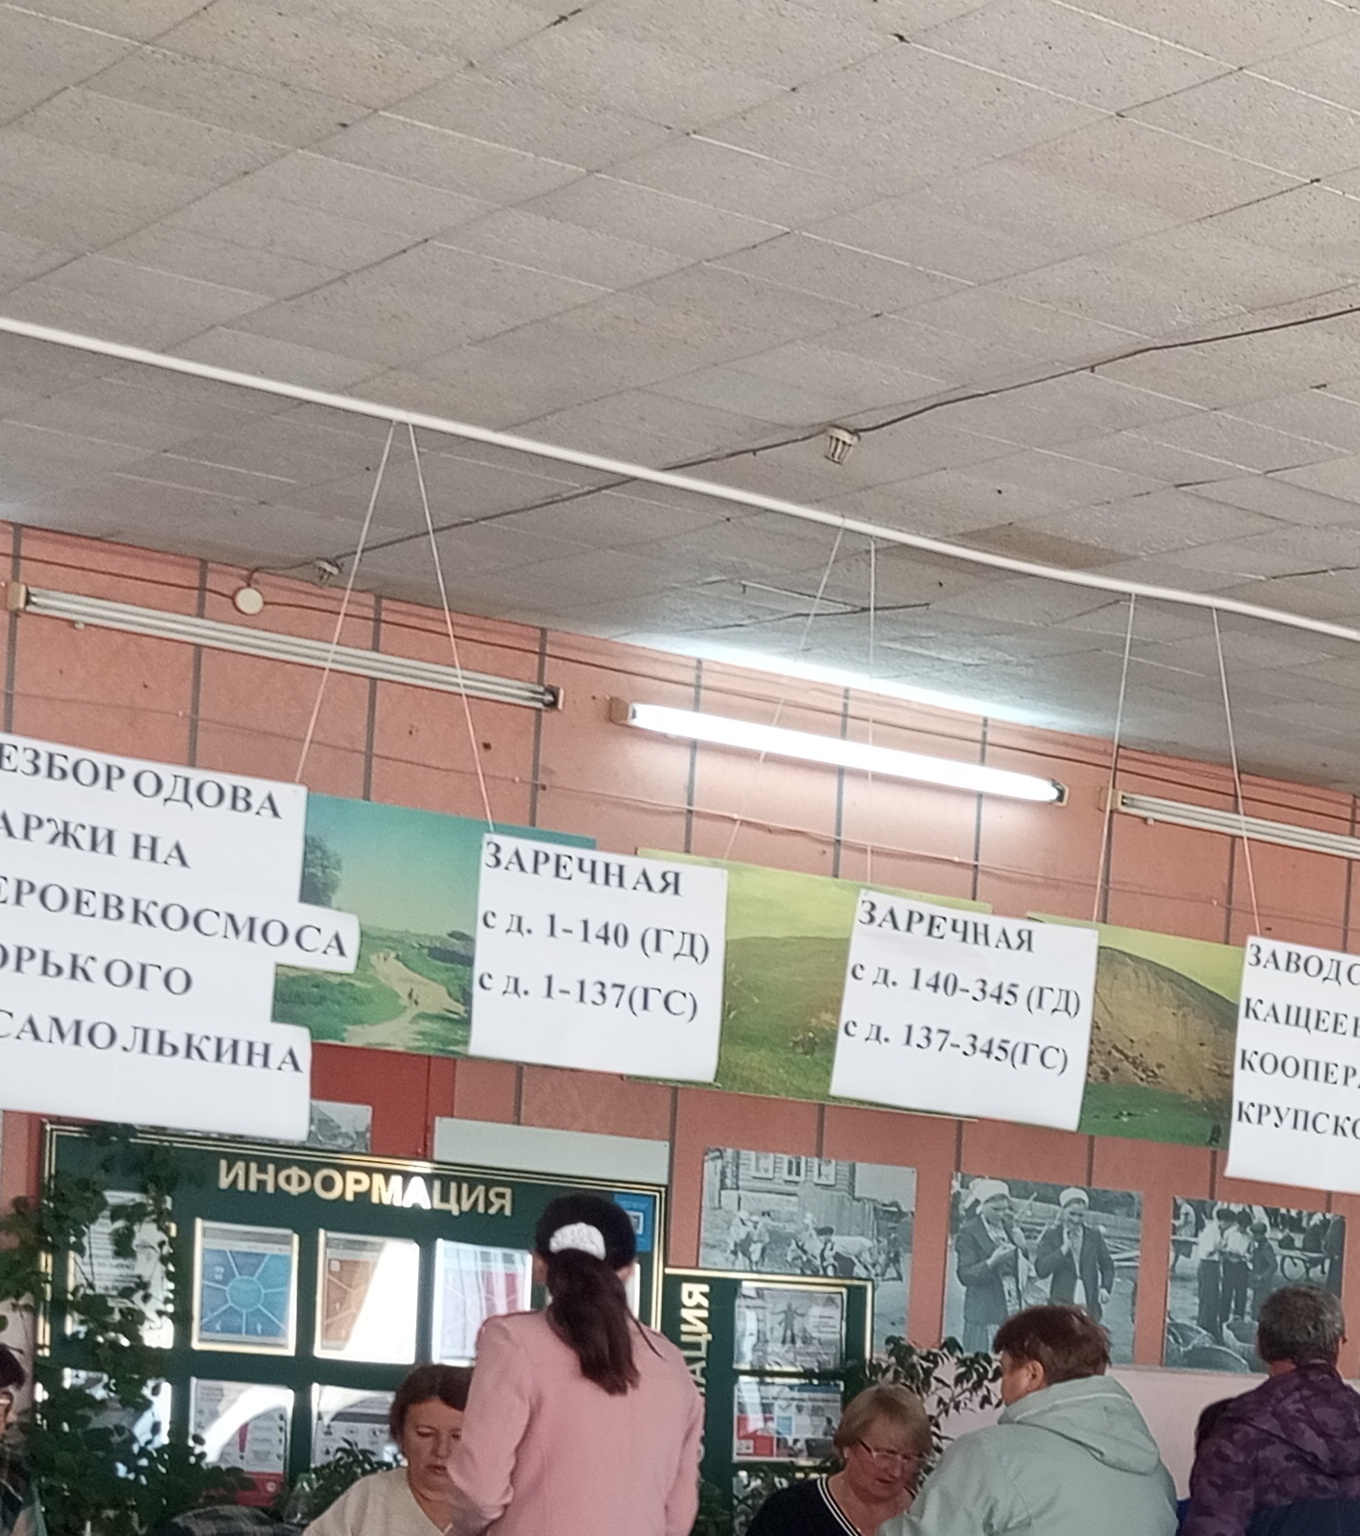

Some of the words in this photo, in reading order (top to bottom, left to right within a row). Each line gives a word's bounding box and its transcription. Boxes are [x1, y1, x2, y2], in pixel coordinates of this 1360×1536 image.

[485, 840, 681, 896] ЗАРЕЧНАЯ
[482, 910, 497, 930] с
[505, 913, 533, 937] д.
[548, 913, 629, 948] 1-140
[640, 927, 710, 965] (ГД)
[858, 899, 1033, 953] ЗАРЕЧНАЯ
[0, 943, 193, 996] РЬКОГО
[478, 972, 493, 991] с
[501, 975, 530, 999] д.
[850, 963, 865, 981] с
[871, 966, 898, 989] д.
[912, 967, 1020, 1007] 140-345
[1026, 986, 1081, 1018] (ГД)
[843, 1020, 858, 1038] с
[864, 1023, 890, 1045] д.
[217, 1158, 513, 1216] ИНФОРМАЦИЯ
